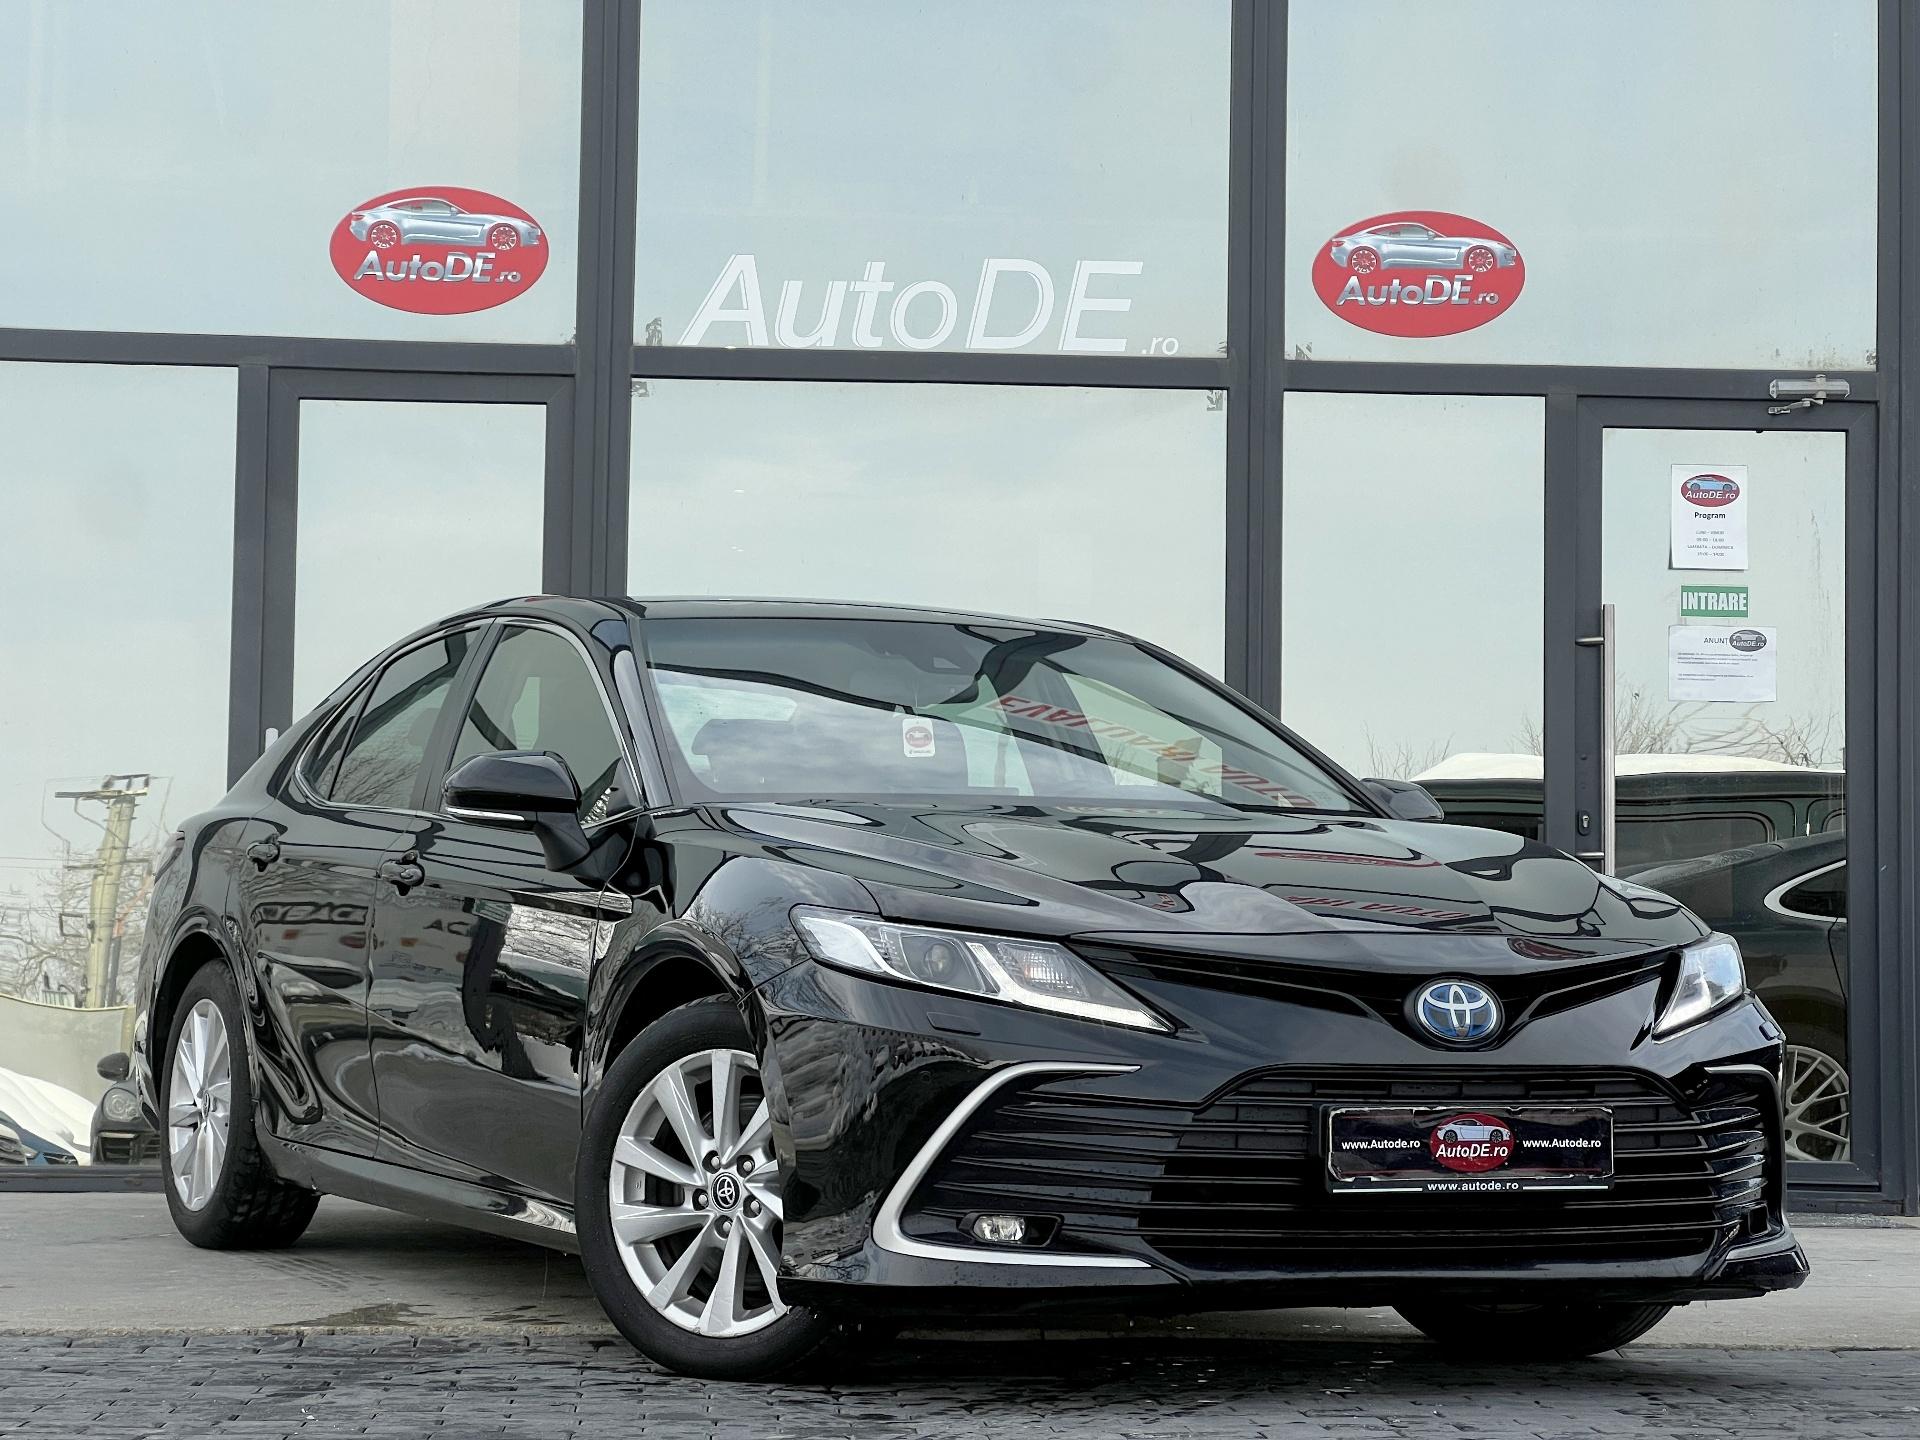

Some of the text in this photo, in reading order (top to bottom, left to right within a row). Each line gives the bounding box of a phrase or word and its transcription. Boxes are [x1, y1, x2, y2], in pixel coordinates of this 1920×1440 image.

[1685, 490, 1736, 500] AutoDE.ro
[1694, 512, 1726, 520] Program
[1682, 592, 1747, 611] INTRARE
[1341, 1137, 1421, 1151] www.Autode.ro
[1522, 1137, 1602, 1150] www.Autode.ro
[1435, 1143, 1509, 1159] AutoDE.ro
[1427, 1181, 1519, 1192] www.autode.ro
